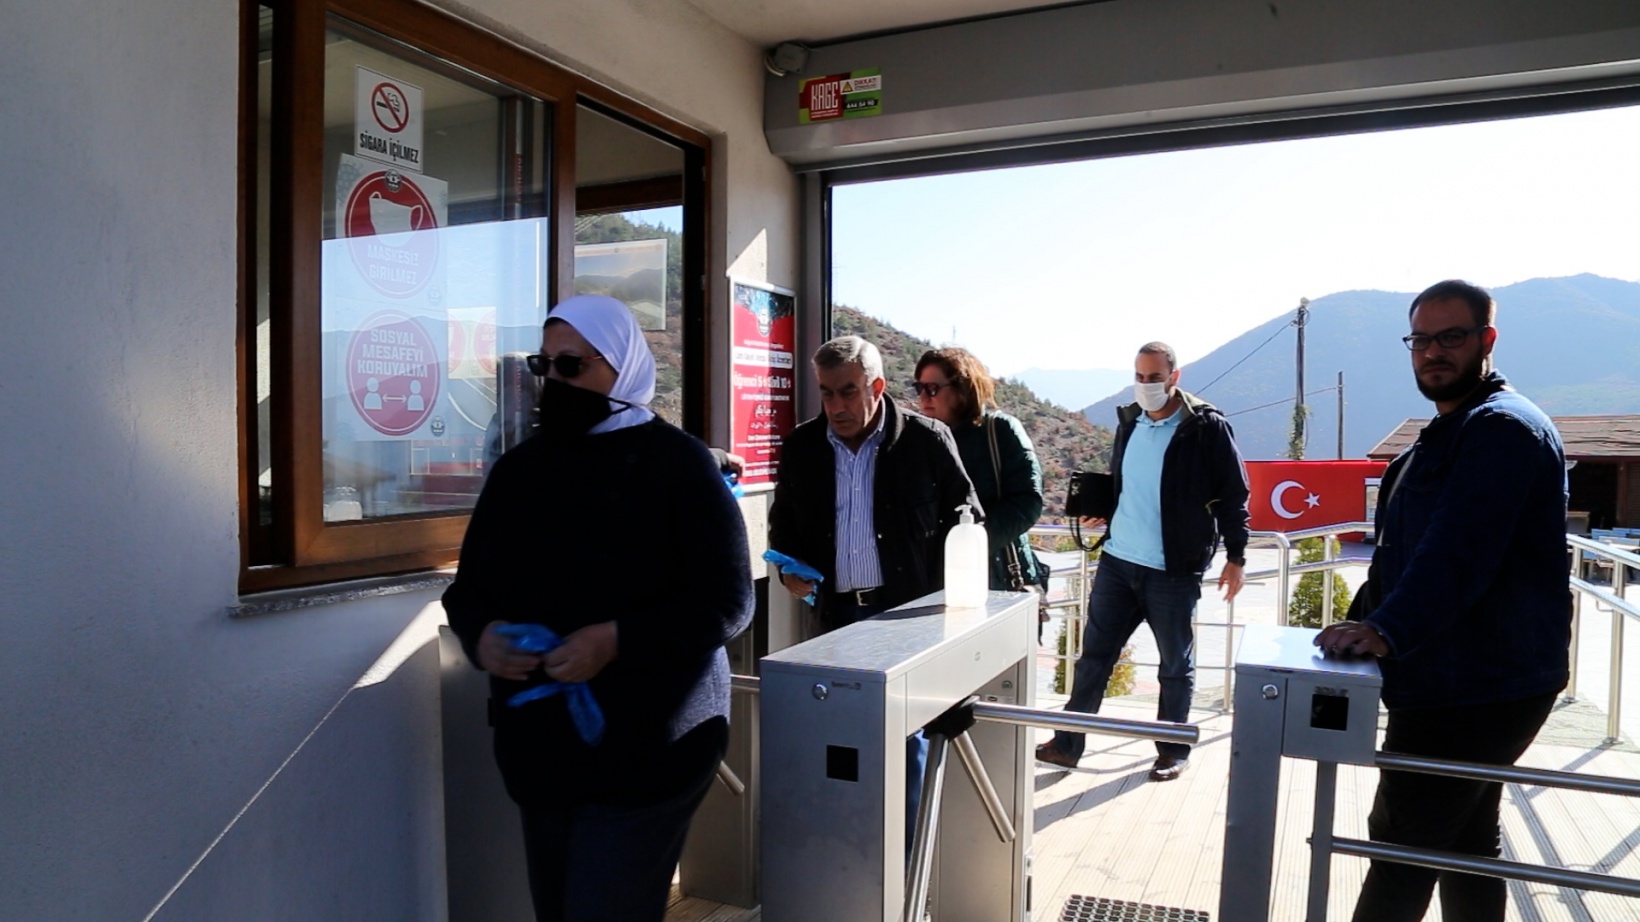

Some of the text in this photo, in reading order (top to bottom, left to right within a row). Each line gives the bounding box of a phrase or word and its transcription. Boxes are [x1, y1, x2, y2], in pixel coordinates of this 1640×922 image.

[811, 81, 839, 111] KAGE
[360, 130, 419, 163] SİGARA İÇİLMEZ
[367, 243, 419, 266] MASKESİZ
[368, 262, 417, 285] GİRİLMEZ
[370, 329, 417, 346] SOSYAL
[362, 343, 424, 362] MESAFEYİ
[357, 359, 428, 378] KORUYALIM
